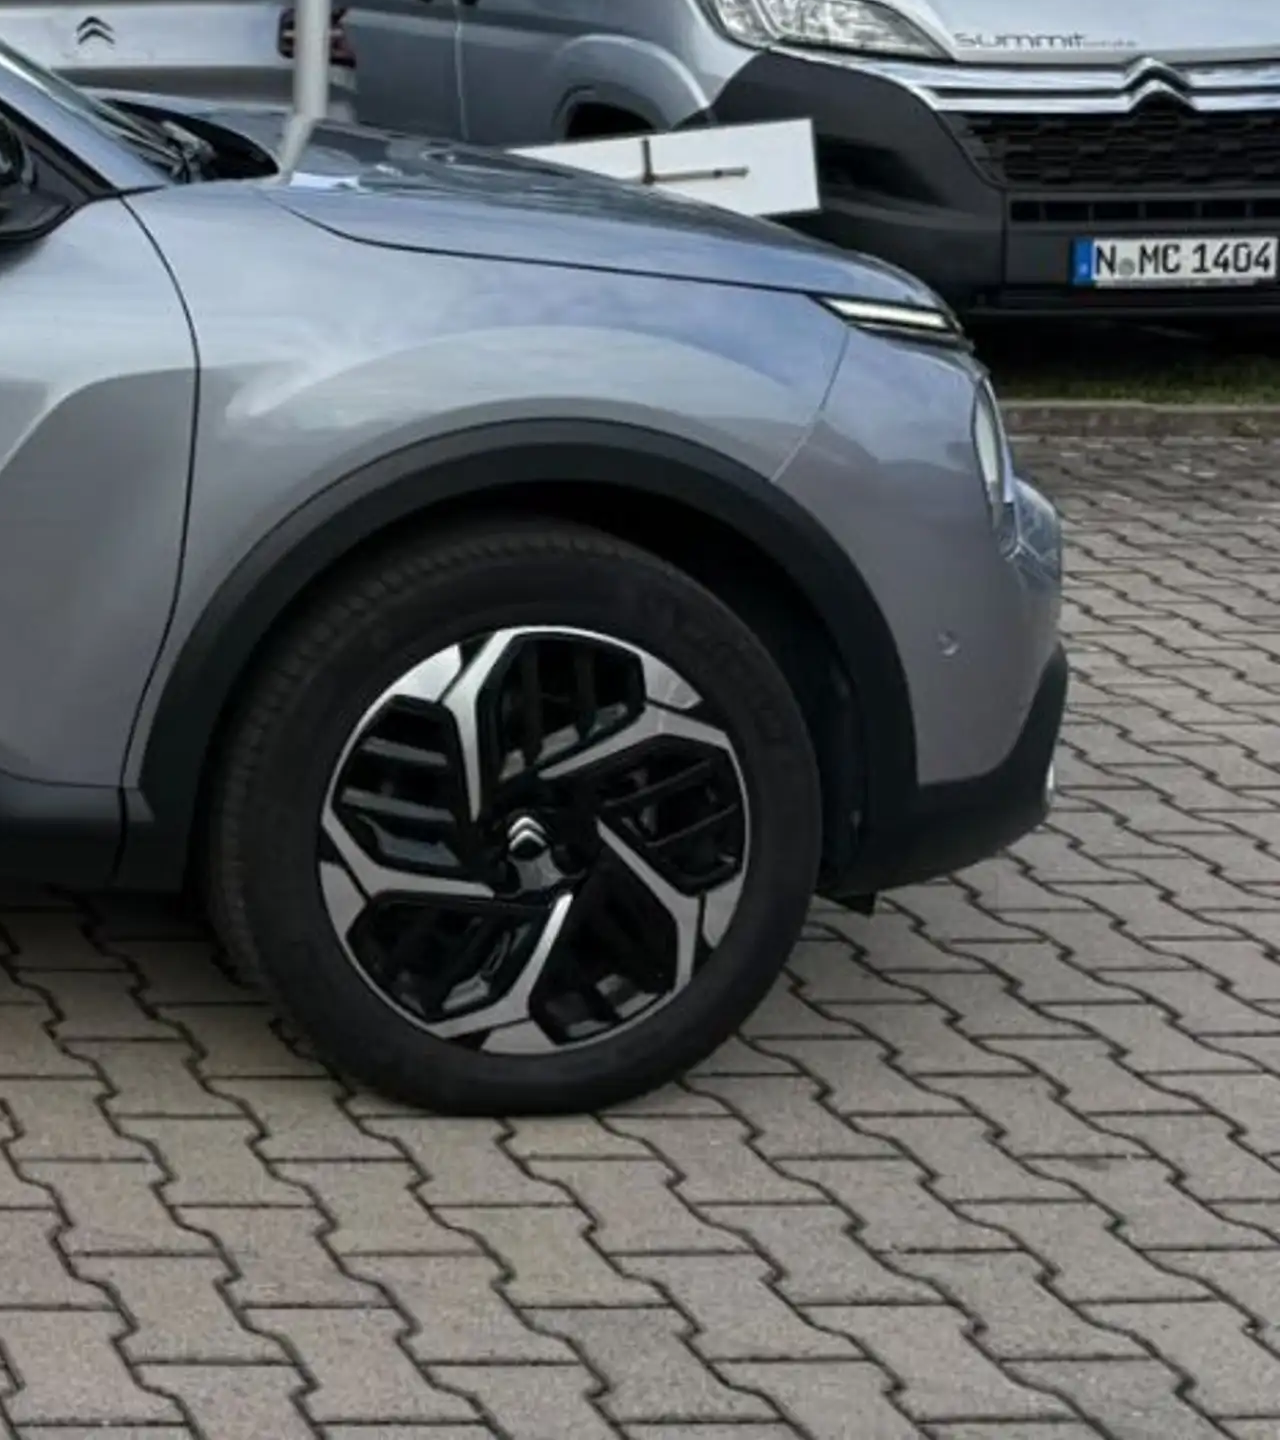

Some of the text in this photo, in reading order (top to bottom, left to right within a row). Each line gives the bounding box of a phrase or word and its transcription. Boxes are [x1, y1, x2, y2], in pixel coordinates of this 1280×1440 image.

[1096, 241, 1272, 275] N MC 1404
